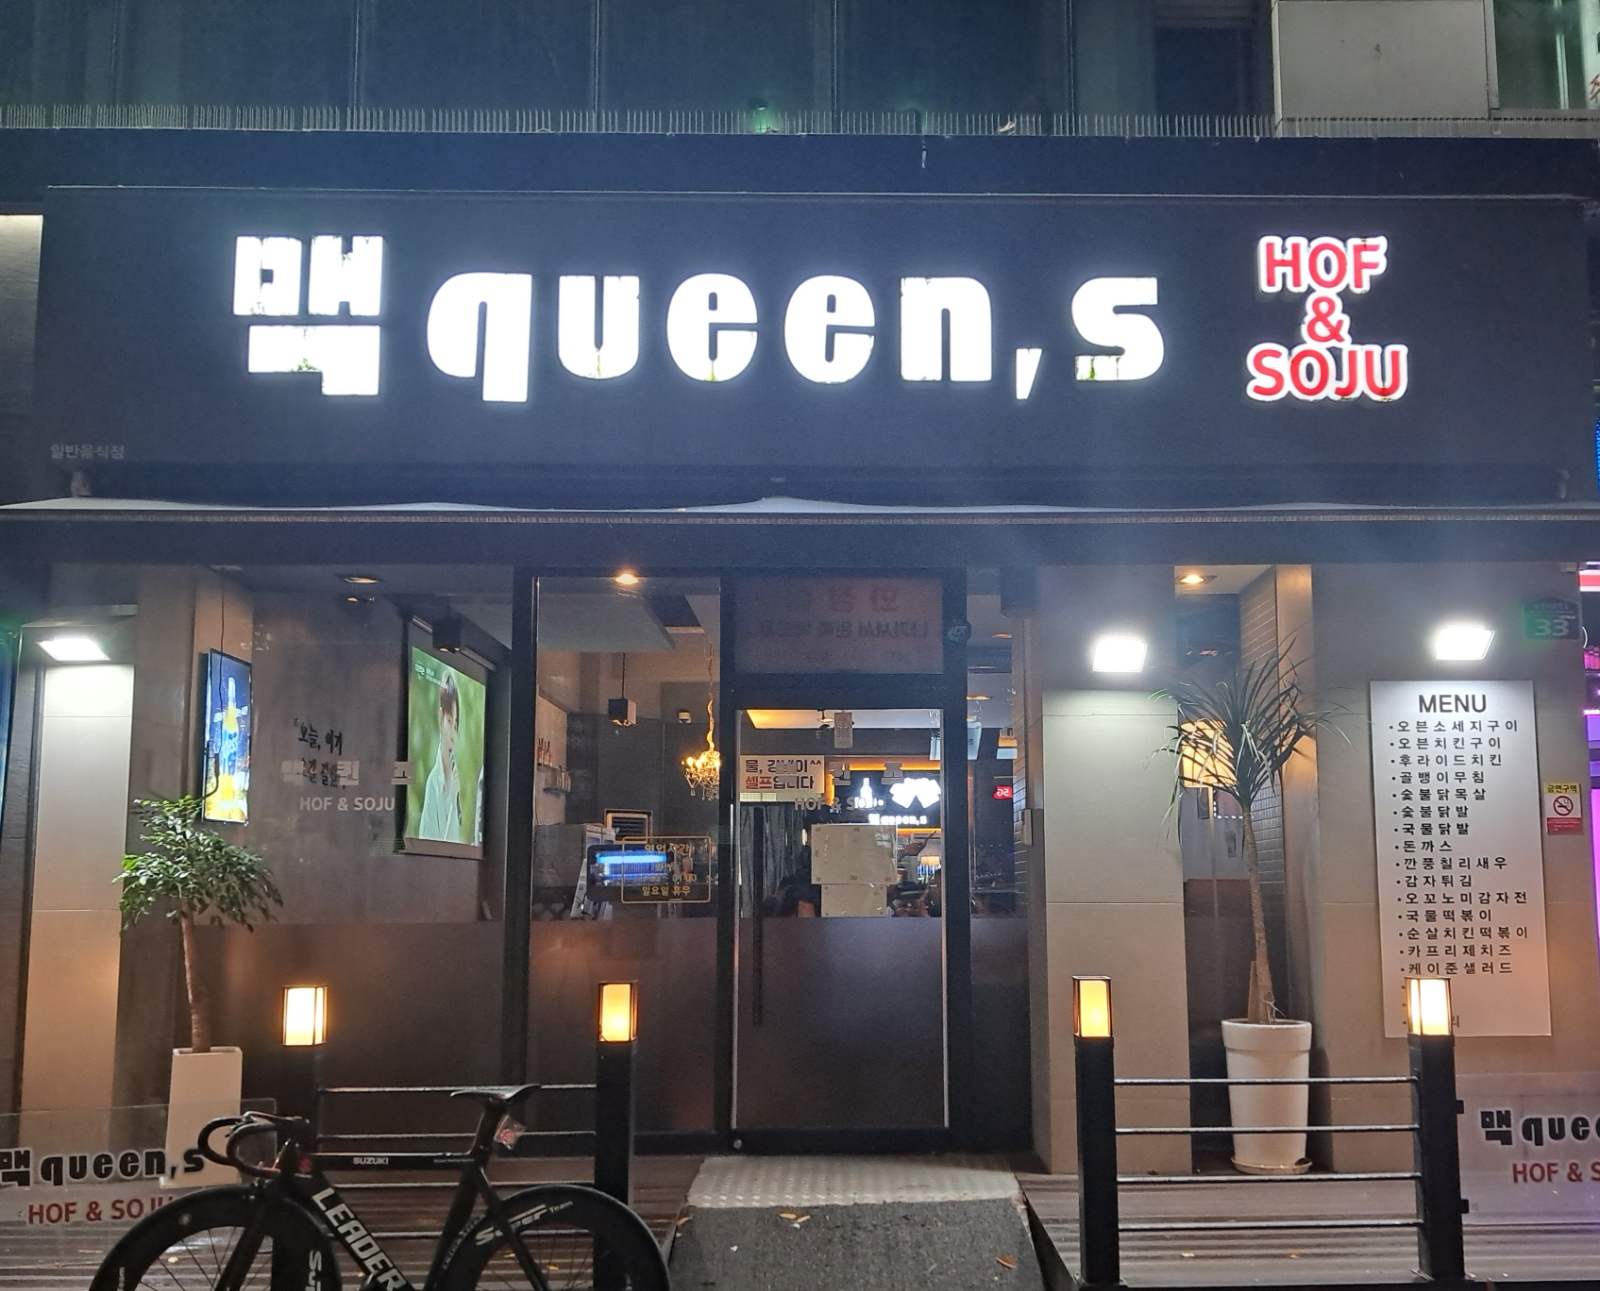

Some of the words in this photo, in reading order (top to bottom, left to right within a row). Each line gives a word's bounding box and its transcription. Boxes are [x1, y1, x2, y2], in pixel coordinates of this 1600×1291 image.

[1260, 236, 1387, 293] HOF
[1305, 292, 1351, 347] &
[1246, 343, 1409, 402] SOJU
[50, 444, 124, 460] 일반음식점
[1534, 619, 1569, 637] 33
[1418, 694, 1487, 713] MENU
[299, 797, 333, 811] HOF
[337, 797, 349, 811] &
[353, 797, 396, 811] SOJU
[353, 1157, 389, 1165] SUZUKI
[1512, 1162, 1558, 1183] HOF
[1567, 1162, 1583, 1183] &
[28, 1203, 77, 1224] HOF
[86, 1201, 103, 1221] &
[312, 1187, 408, 1291] LEADER
